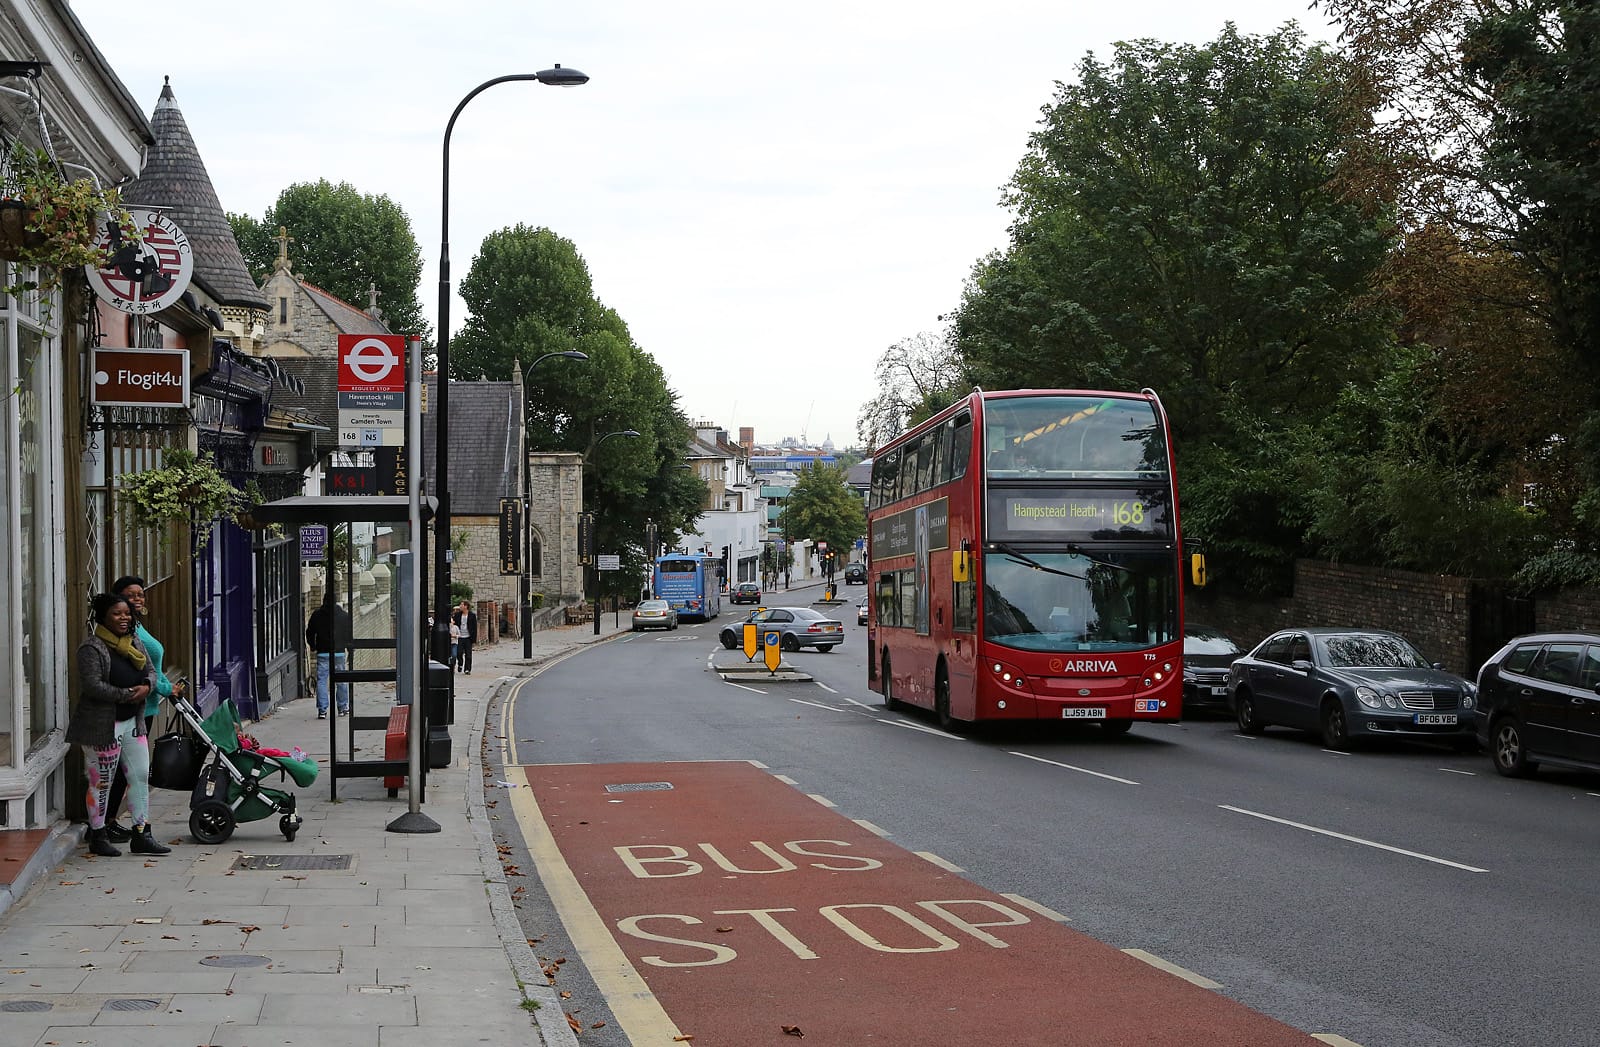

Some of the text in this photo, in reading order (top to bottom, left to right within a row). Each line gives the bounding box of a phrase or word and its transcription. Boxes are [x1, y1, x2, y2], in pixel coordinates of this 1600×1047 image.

[147, 212, 190, 255] CLINIC
[117, 369, 182, 390] Flogit4u
[342, 432, 356, 440] 168
[333, 472, 344, 489] K
[346, 475, 357, 488] &
[394, 446, 406, 494] ILLAGE
[1014, 501, 1144, 525] Hampstead Heath 168
[1064, 660, 1118, 673] ARRIVA
[1065, 709, 1103, 717] LJ59 ABN
[1419, 715, 1456, 723] BF06 VBC
[613, 839, 884, 879] BUS
[616, 899, 1032, 968] STOP
